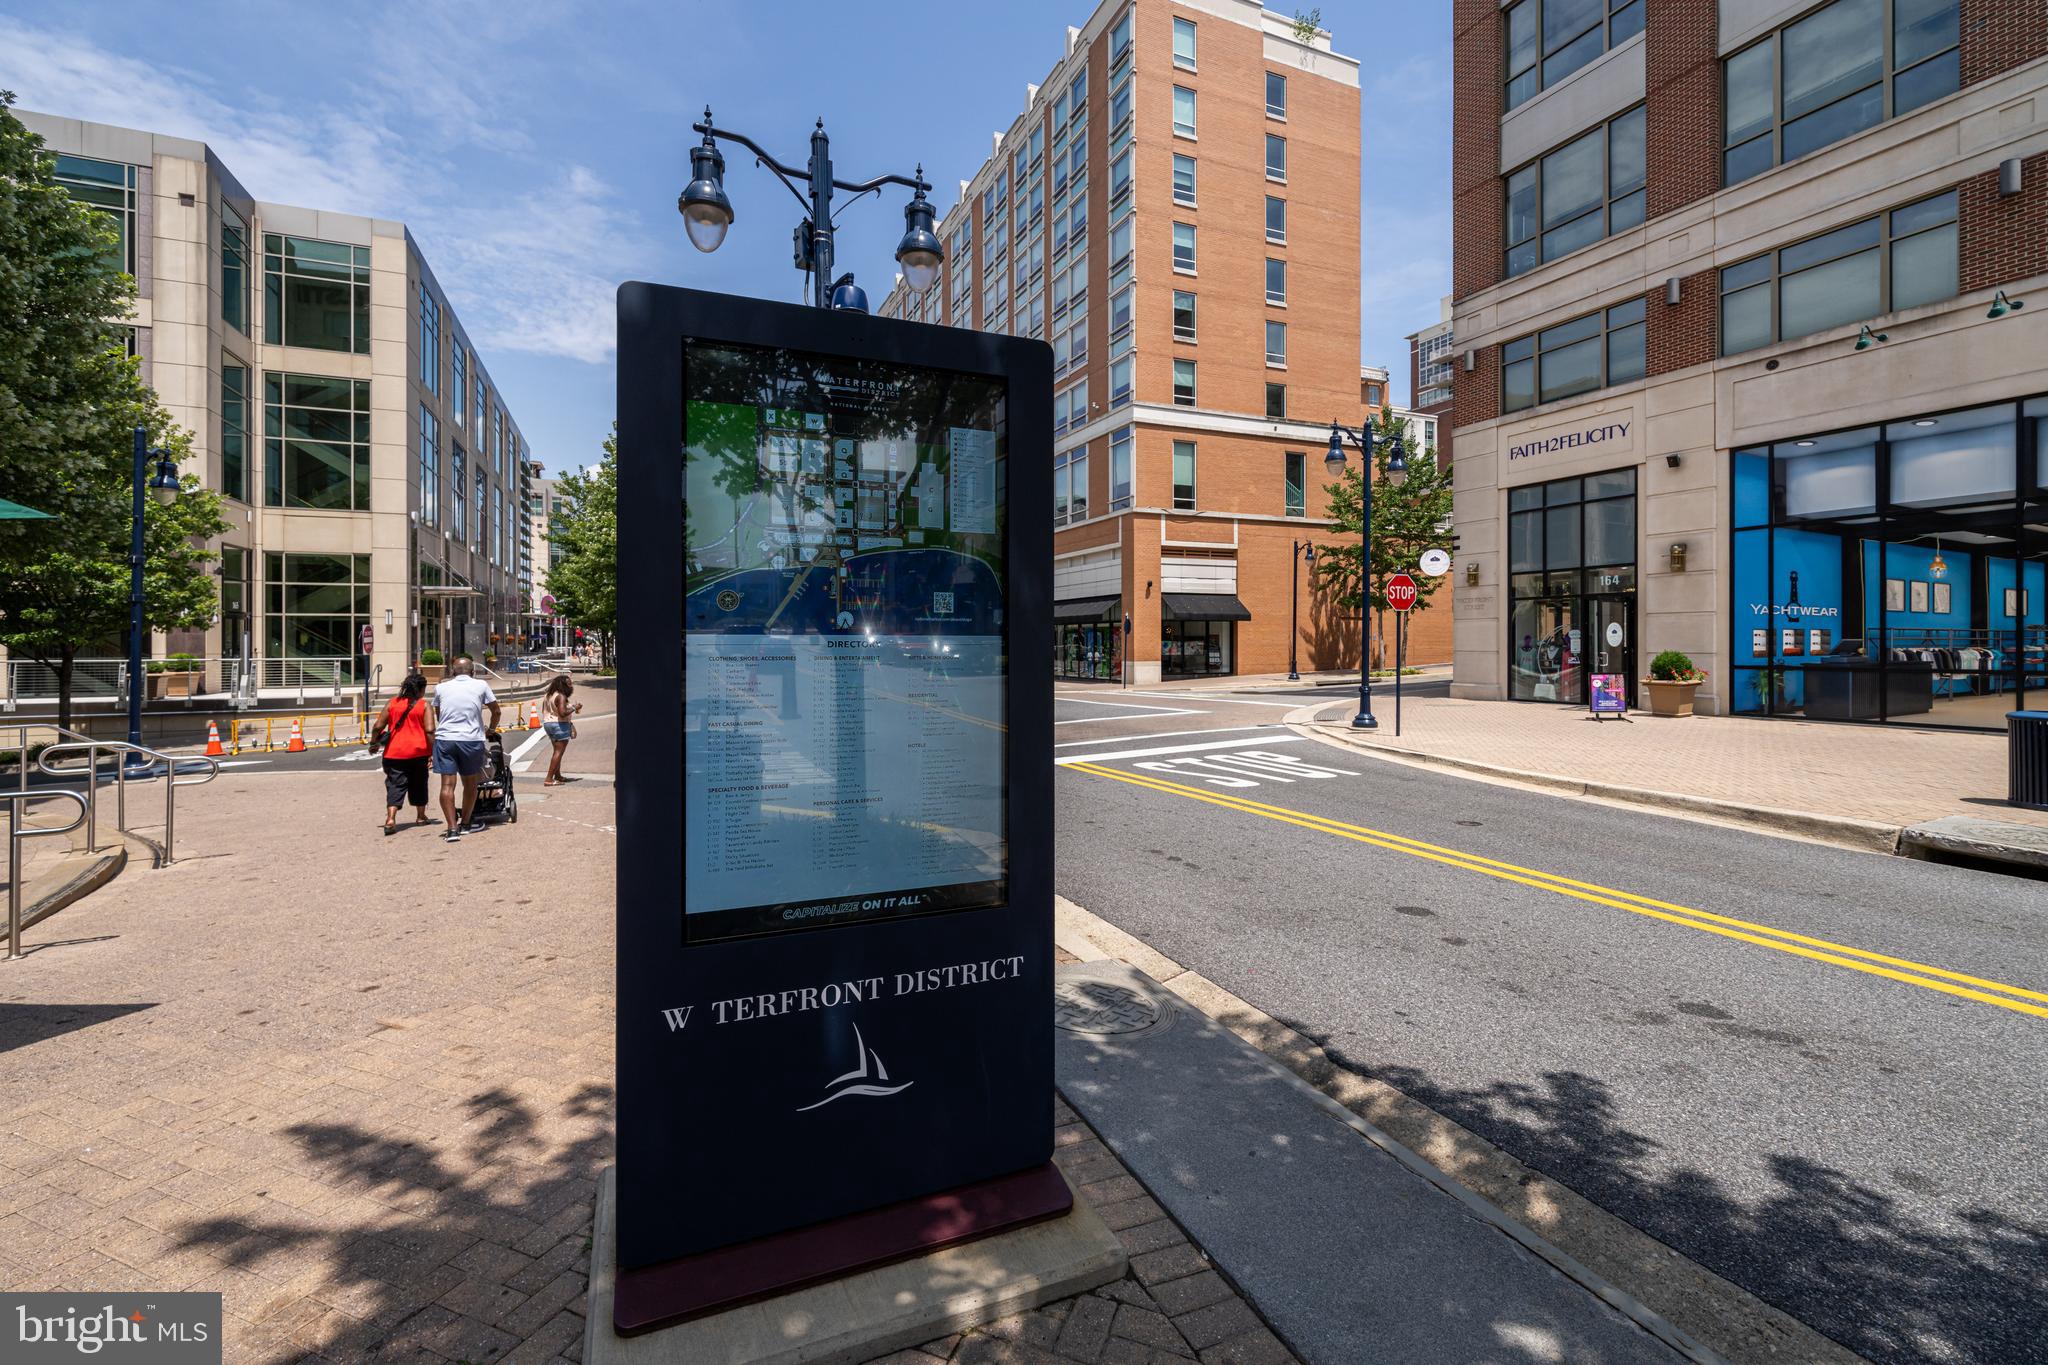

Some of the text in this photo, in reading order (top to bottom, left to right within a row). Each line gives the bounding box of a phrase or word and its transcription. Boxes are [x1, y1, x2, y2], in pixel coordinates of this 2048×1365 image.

[816, 375, 902, 391] WATERFRONT
[1510, 422, 1631, 461] FAITH2FELICITY
[1599, 575, 1620, 587] 164
[1389, 585, 1415, 600] STOP
[1750, 604, 1838, 617] YACHTWEAR
[827, 640, 881, 649] DIRECTORY
[1132, 750, 1362, 788] STOP
[782, 896, 921, 920] CAPITALIZE ON IT ALL
[894, 955, 1025, 997] DISTRICT
